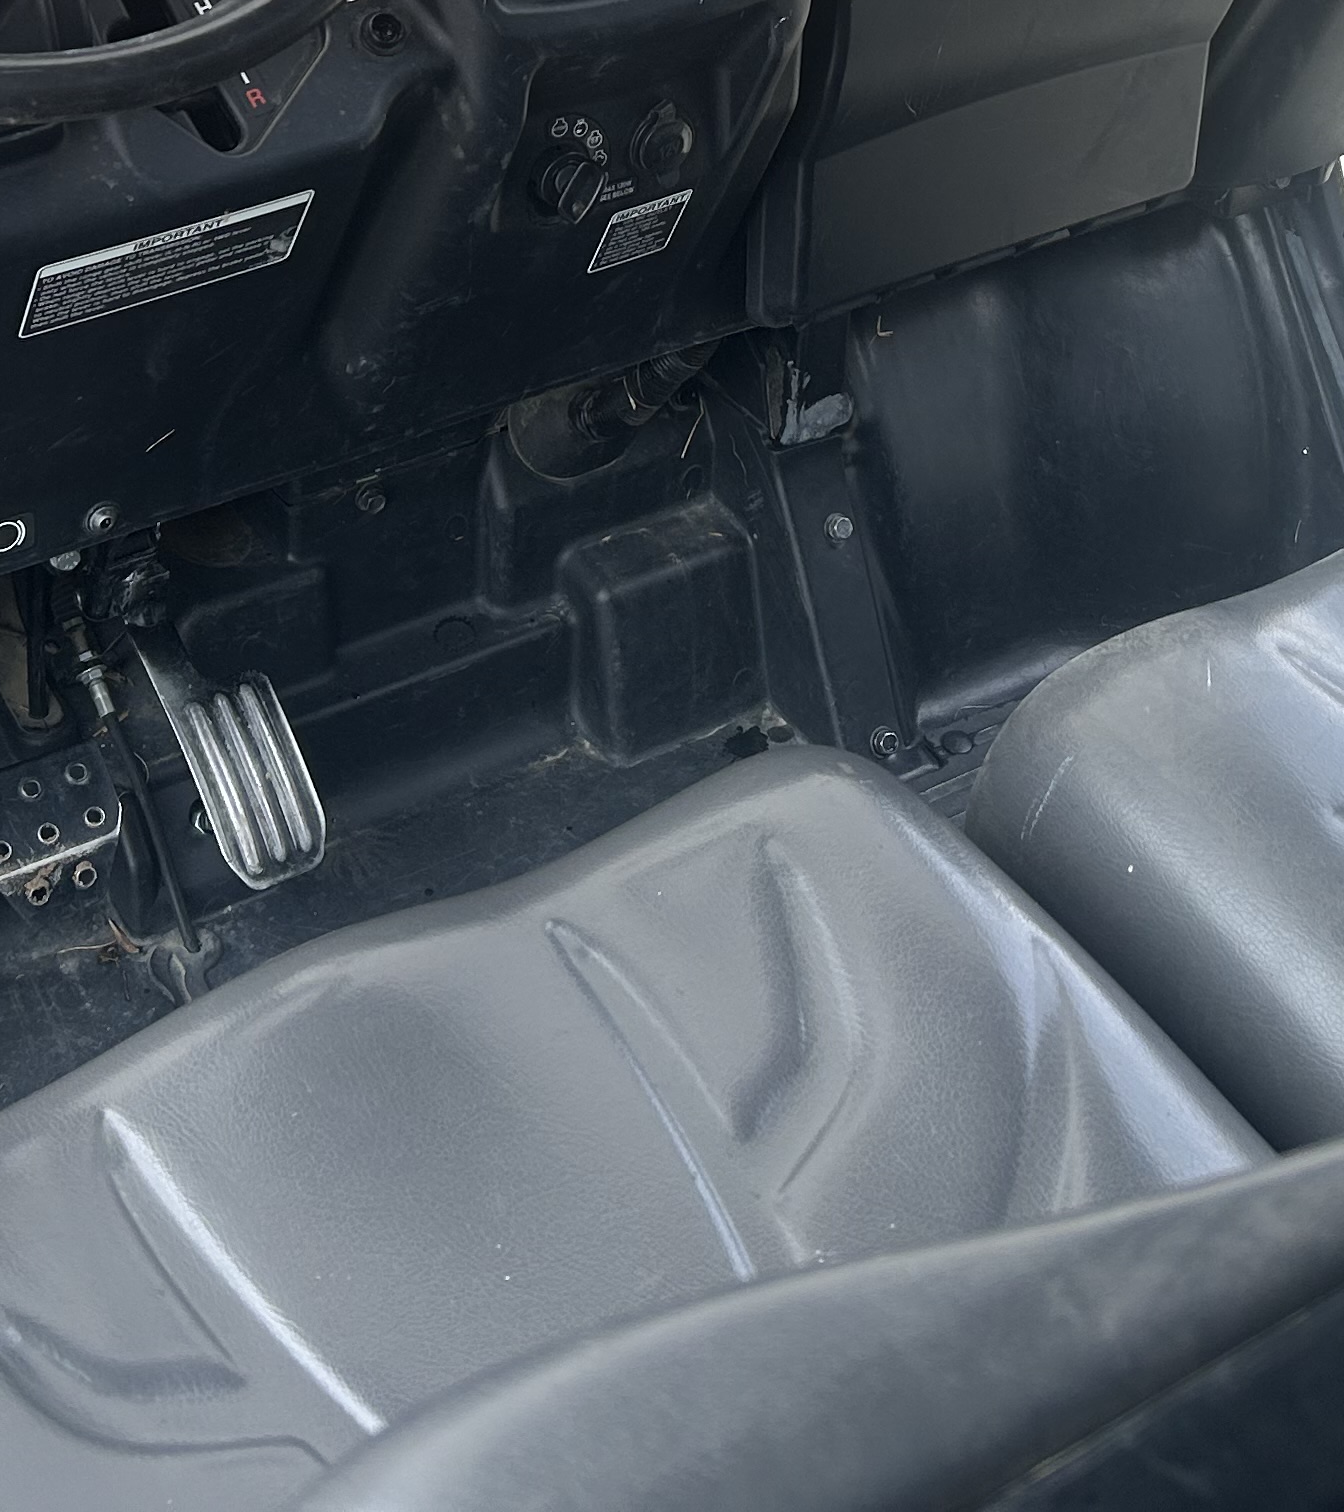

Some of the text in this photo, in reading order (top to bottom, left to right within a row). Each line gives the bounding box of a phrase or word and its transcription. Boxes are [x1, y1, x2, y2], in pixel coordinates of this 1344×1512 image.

[246, 88, 266, 109] R
[616, 193, 689, 222] IMPORTANT
[133, 219, 224, 251] IMPORTANT
